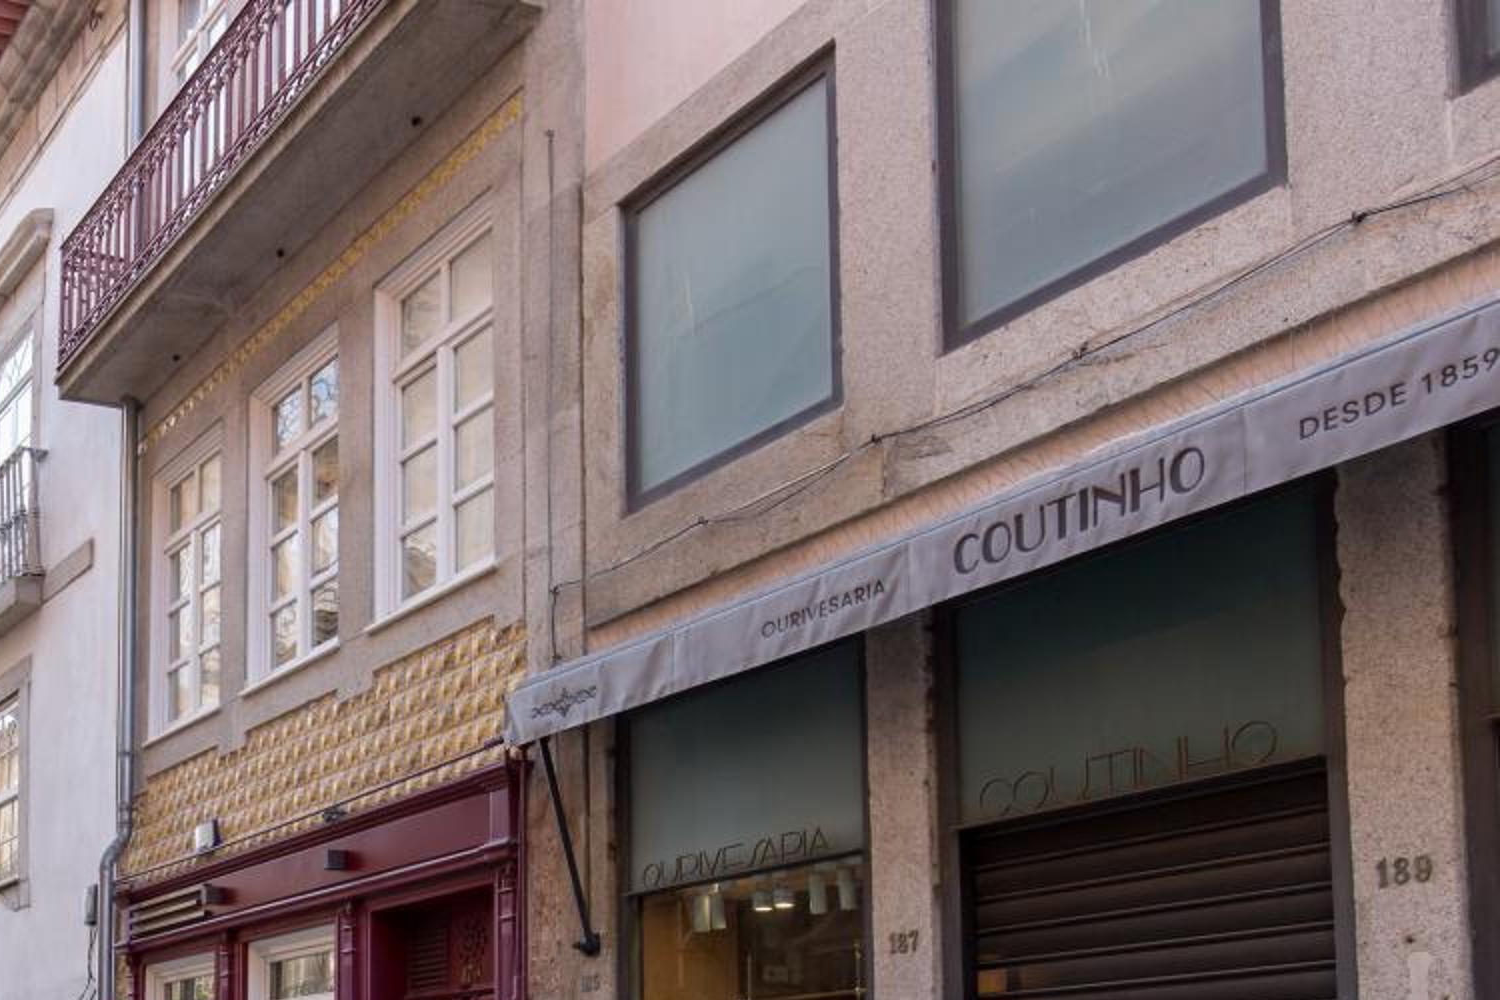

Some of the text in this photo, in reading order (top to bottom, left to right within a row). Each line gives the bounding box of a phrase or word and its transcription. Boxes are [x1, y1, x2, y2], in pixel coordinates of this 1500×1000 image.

[1299, 347, 1500, 440] DESDE 1859
[953, 446, 1206, 575] COUTINHO
[761, 578, 886, 638] OURIVESARIA
[1375, 855, 1433, 889] 189
